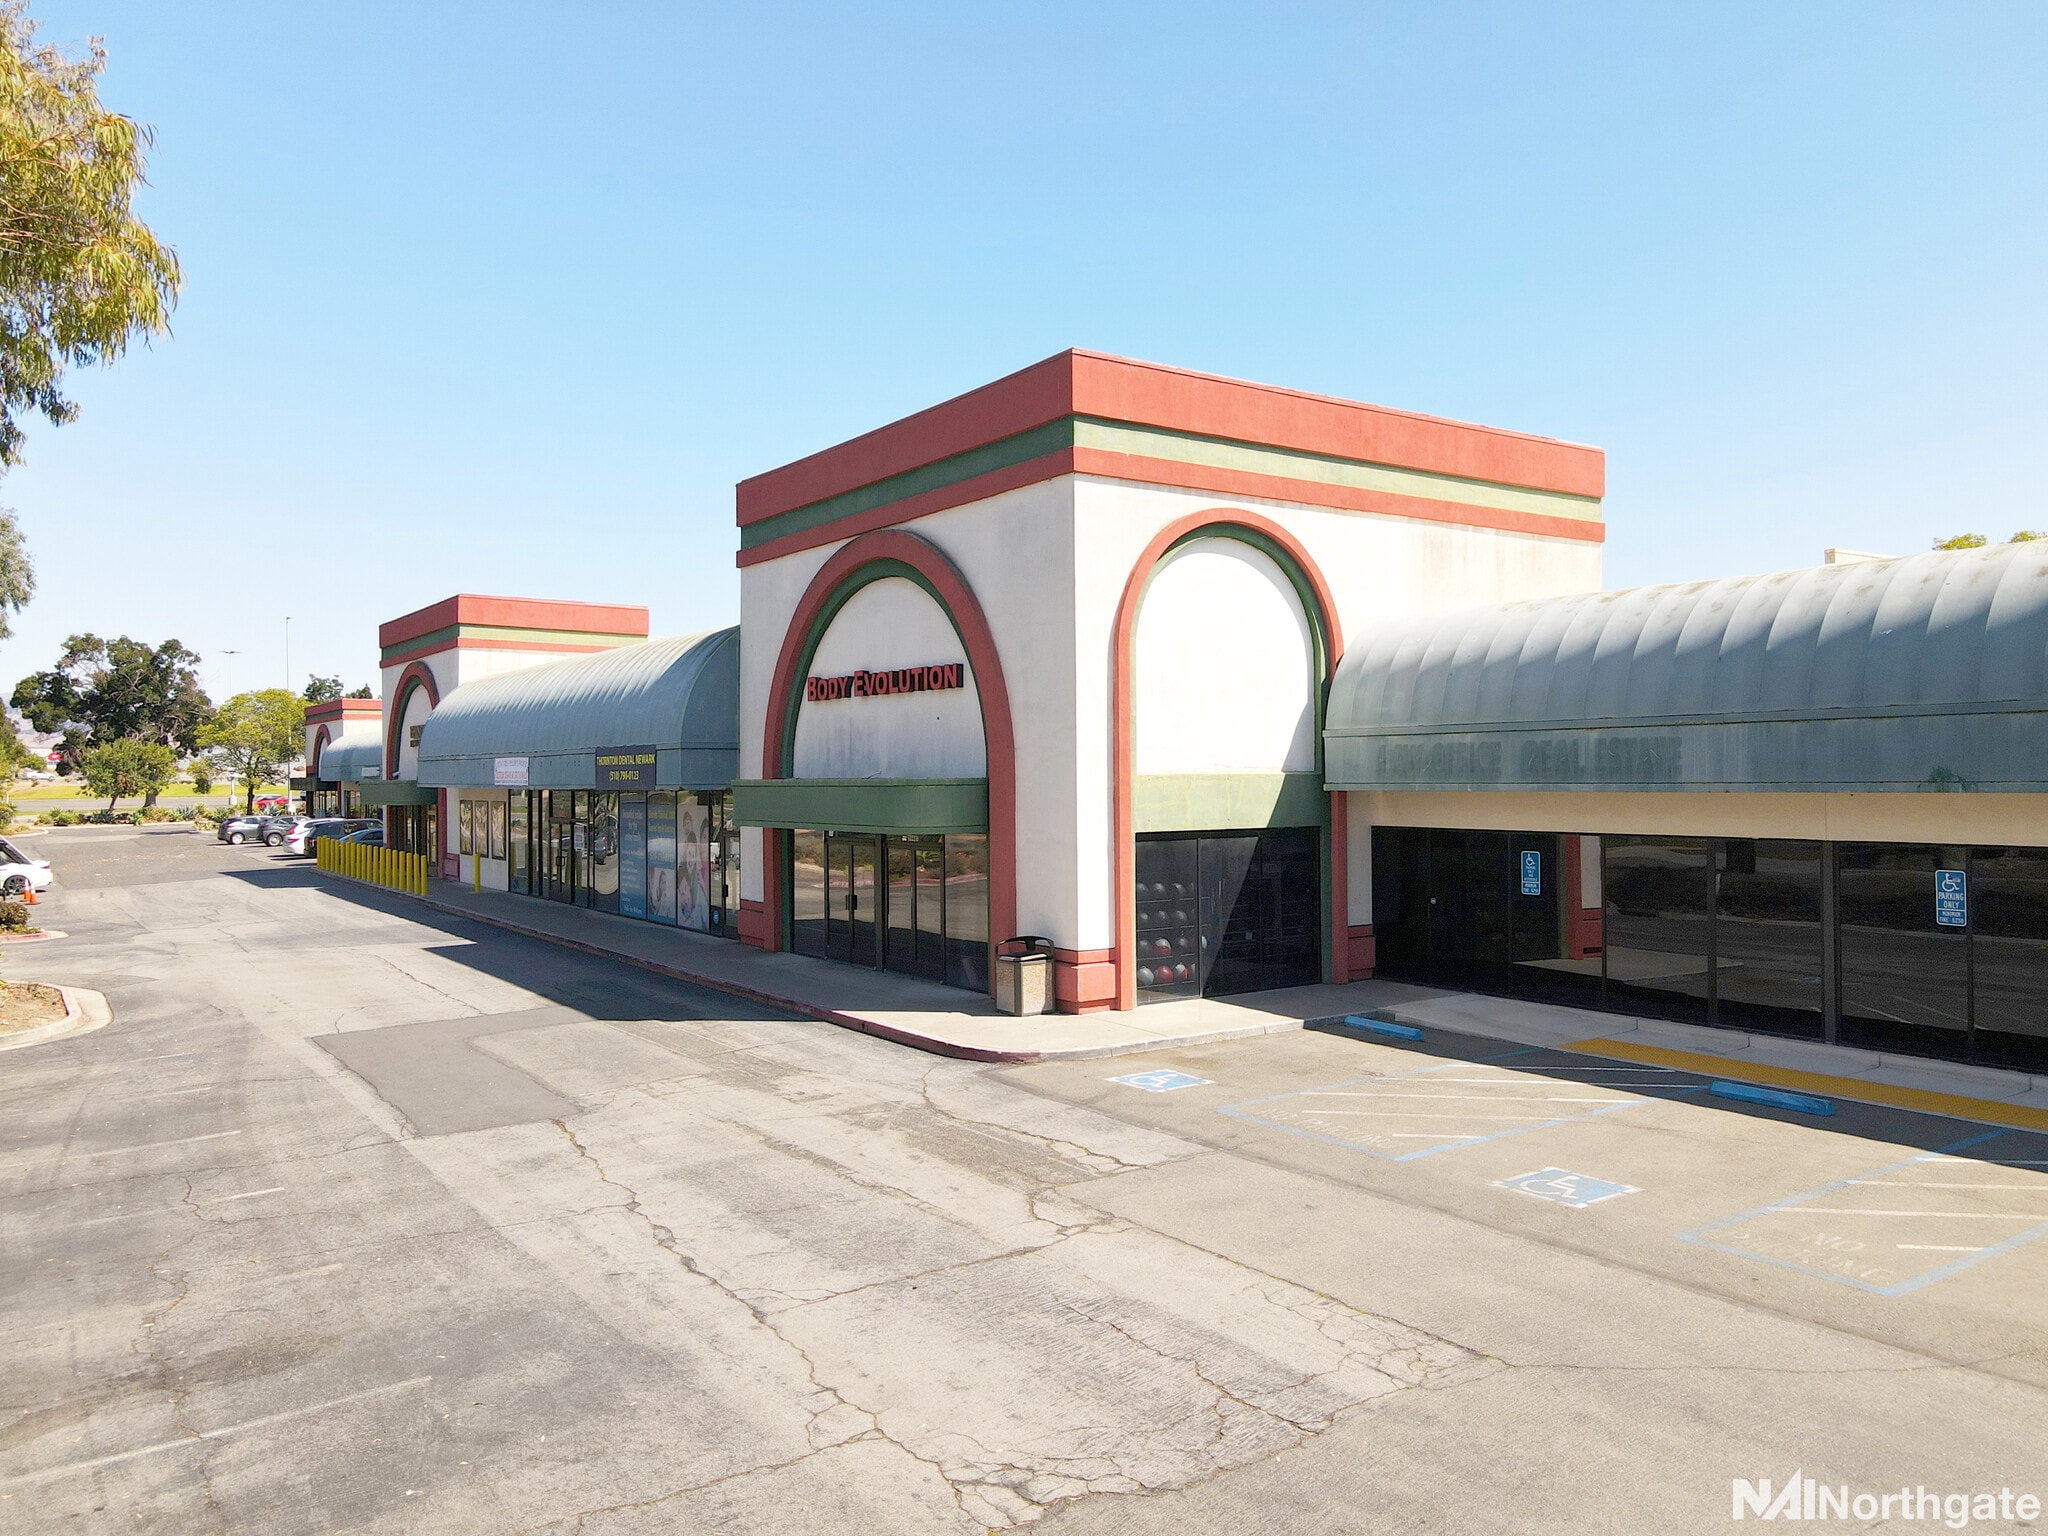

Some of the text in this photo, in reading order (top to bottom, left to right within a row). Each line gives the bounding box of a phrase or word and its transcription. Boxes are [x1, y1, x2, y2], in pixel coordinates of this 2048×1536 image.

[808, 663, 963, 701] BODY EVOLUTION
[619, 754, 635, 765] DENTAL
[636, 753, 656, 764] NEWARK
[1938, 891, 1964, 901] PARKING
[1943, 900, 1960, 909] ONLY
